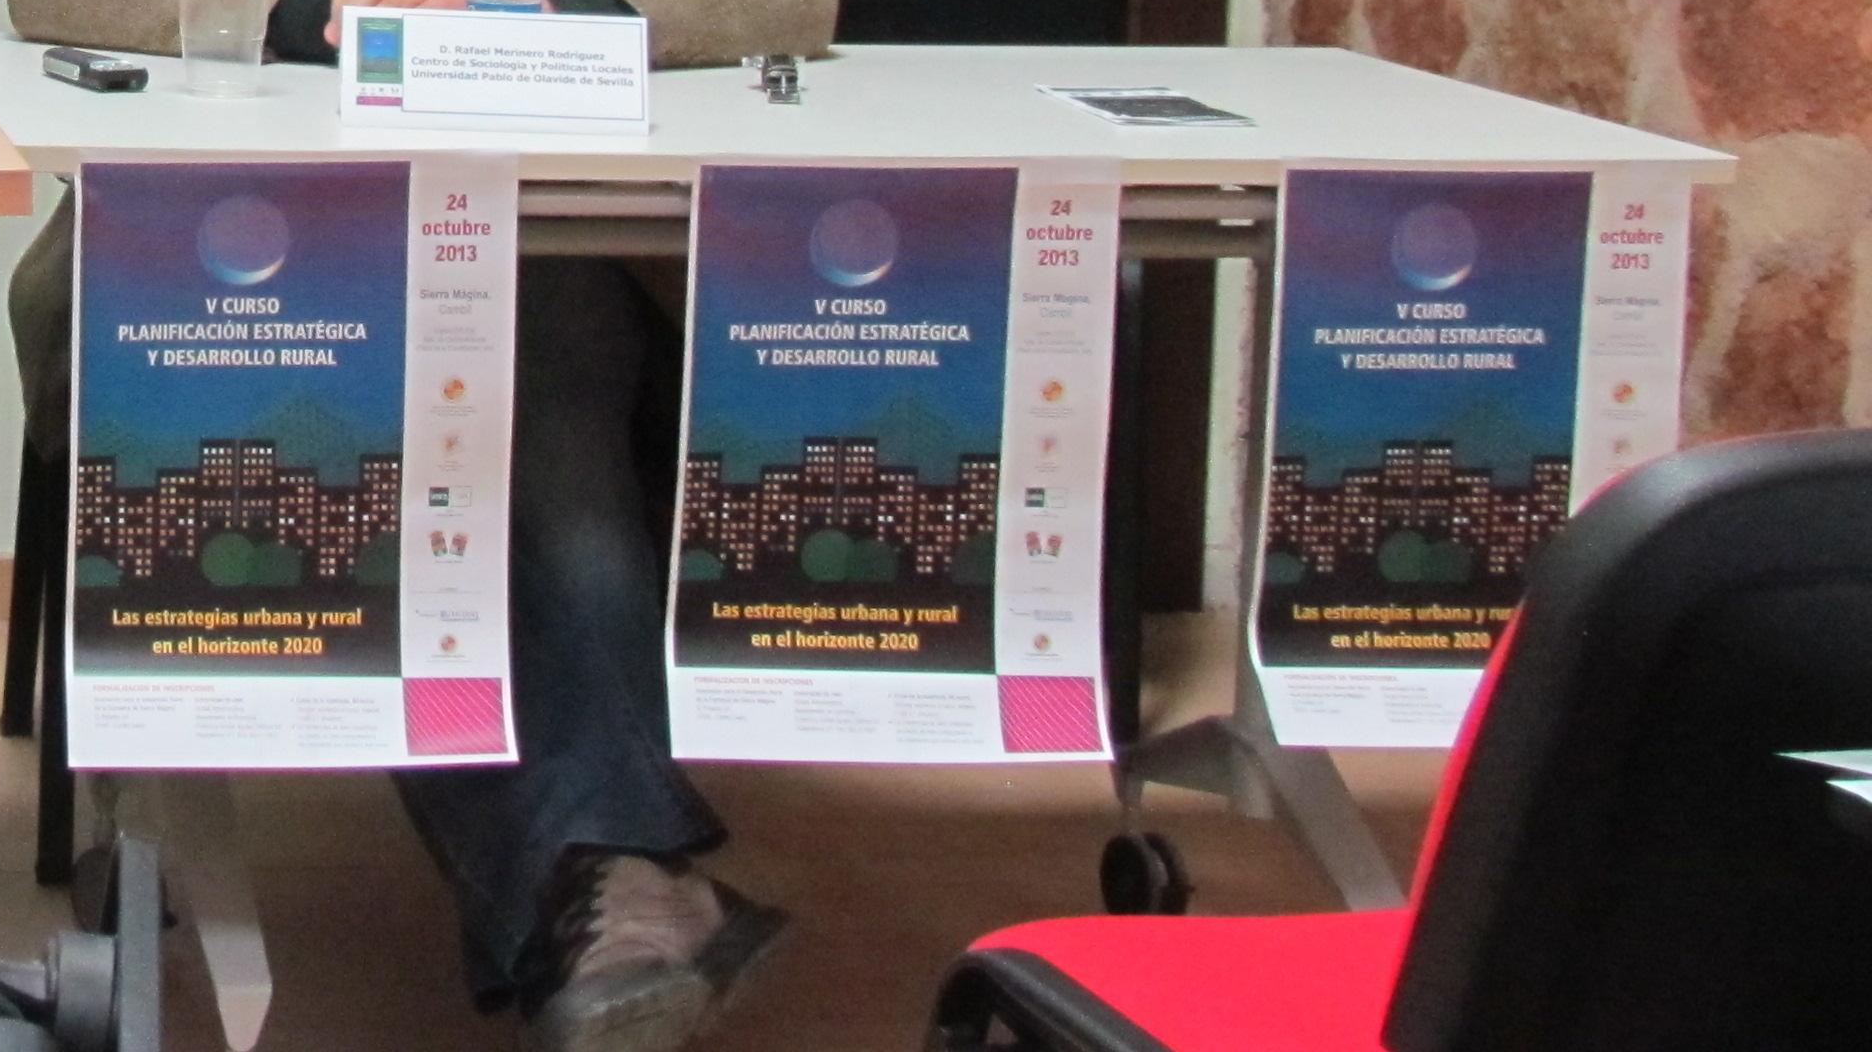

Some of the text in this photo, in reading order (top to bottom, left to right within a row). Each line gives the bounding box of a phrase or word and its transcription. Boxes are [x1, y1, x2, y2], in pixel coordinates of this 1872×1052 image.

[439, 45, 451, 54] D.
[455, 46, 490, 55] Rafael
[494, 47, 544, 58] Merinero
[411, 57, 449, 66] Centro
[452, 58, 466, 67] de
[592, 65, 633, 74] Locales
[411, 70, 633, 87] Universidad Pablo de Olavide de Sevilla
[446, 194, 467, 210] 24
[1051, 200, 1071, 215] 24
[422, 220, 491, 236] octubre
[1026, 224, 1093, 240] octubre
[435, 245, 477, 262] 2013
[1038, 250, 1079, 266] 2013
[420, 289, 450, 299] Sierra
[205, 298, 280, 314] V CURSO
[815, 299, 886, 315] V CURSO
[1397, 303, 1466, 319] V CURSO
[118, 320, 367, 341] PLANIFICACIÓN ESTRATÉGICA
[729, 322, 970, 341] PLANIFICACIÓN ESTRATÉGICA
[1314, 325, 1545, 345] PLANIFICACIÓN ESTRATÉGICA
[147, 349, 337, 366] Y DESARROLLO RURAL
[757, 349, 939, 366] Y DESARROLLO RURAL
[1341, 353, 1515, 369] Y DESARROLLO RURAL
[112, 608, 362, 629] Las estrategias urbana y rural
[712, 602, 958, 626] Las estrategias urbana y rural
[153, 637, 322, 654] en el horizonte 2020
[751, 630, 919, 649] en el horizonte 2020
[1331, 631, 1491, 648] en el horizonte 2020
